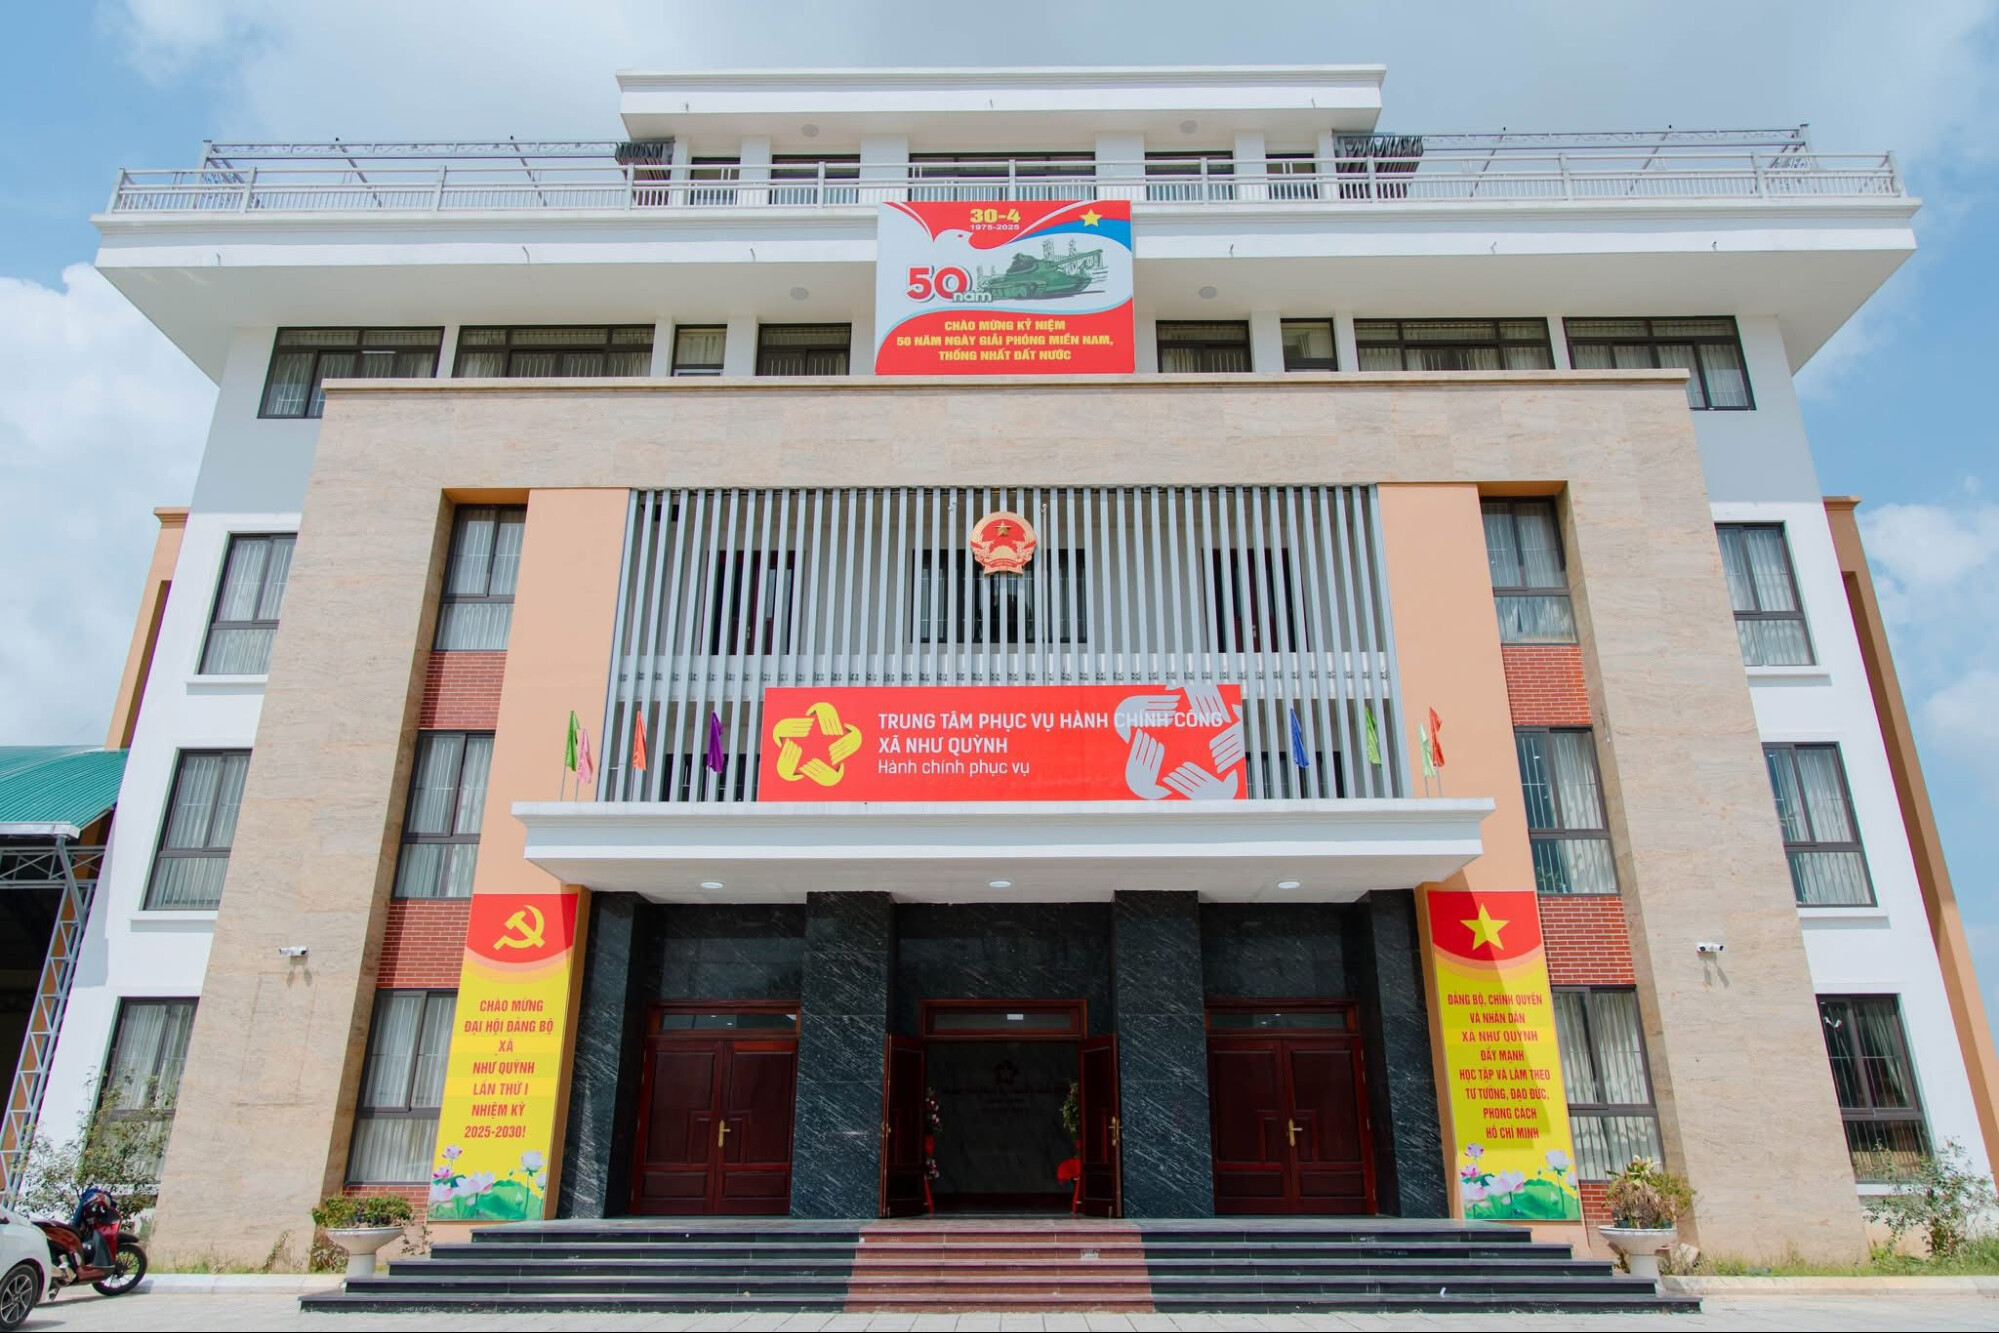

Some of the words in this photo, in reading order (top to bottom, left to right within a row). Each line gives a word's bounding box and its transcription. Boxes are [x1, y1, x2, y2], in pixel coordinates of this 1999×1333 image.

[970, 208, 1021, 223] 30-4
[906, 266, 969, 301] 50
[944, 318, 975, 331] CHÀO
[979, 319, 1014, 331] MỪNG
[1017, 317, 1031, 331] KỶ
[1035, 318, 1066, 333] NIỆM
[896, 336, 912, 346] 50
[914, 335, 942, 346] NĂM
[944, 333, 975, 346] NGÀY
[979, 333, 1003, 346] GIẢI
[1006, 334, 1045, 346] PHÓNG
[1082, 335, 1113, 347] NAM,
[938, 347, 977, 360] THỐNG
[980, 347, 1010, 360] NHẤT
[1014, 347, 1036, 360] ĐẤT
[1039, 347, 1072, 360] NƯỚC
[878, 713, 936, 729] TRUNG
[940, 710, 973, 729] TÂM
[978, 713, 1027, 732] PHỤC
[1031, 713, 1055, 732] VỤ
[1060, 709, 1109, 729] HÀNH
[1114, 709, 1169, 728] CHÍNH
[1174, 709, 1223, 728] CÔNG
[878, 734, 901, 753] XÃ
[905, 736, 944, 753] NHƯ
[948, 734, 1008, 756] QUỲNH
[878, 759, 917, 774] Hành
[921, 759, 965, 774] chính
[969, 759, 1008, 777] phục
[1011, 761, 1030, 776] vụ
[479, 997, 508, 1012] CHÀO
[1447, 991, 1470, 1005] ĐẢNG
[1488, 991, 1513, 1005] CHÍNH
[1469, 1010, 1481, 1024] VÀ
[1483, 1010, 1506, 1024] NHÂN
[1508, 1010, 1525, 1024] DÂN
[464, 1020, 483, 1035] ĐẠI
[485, 1018, 504, 1035] HỘI
[506, 1017, 536, 1033] ĐẢNG
[539, 1017, 554, 1035] BỘ
[1478, 1030, 1501, 1042] NHƯ
[1499, 1049, 1525, 1064] MẠNH
[472, 1060, 497, 1074] NHƯ
[498, 1059, 535, 1075] QUỲNH
[1459, 1069, 1476, 1083] HỌC
[1478, 1066, 1494, 1083] TẬP
[1496, 1066, 1507, 1080] VÀ
[1509, 1066, 1527, 1080] LÀM
[1529, 1069, 1551, 1081] THEO
[500, 1080, 523, 1096] THỨ
[524, 1083, 529, 1096] I
[1465, 1087, 1477, 1100] TƯ
[1510, 1087, 1528, 1102] ĐẠO
[471, 1102, 508, 1119] NHIỆM
[1482, 1107, 1512, 1119] PHONG
[1514, 1105, 1537, 1119] CÁCH
[464, 1125, 526, 1138] 2025-2030!
[1499, 1124, 1514, 1139] CHÍ
[1516, 1127, 1539, 1139] MINH
